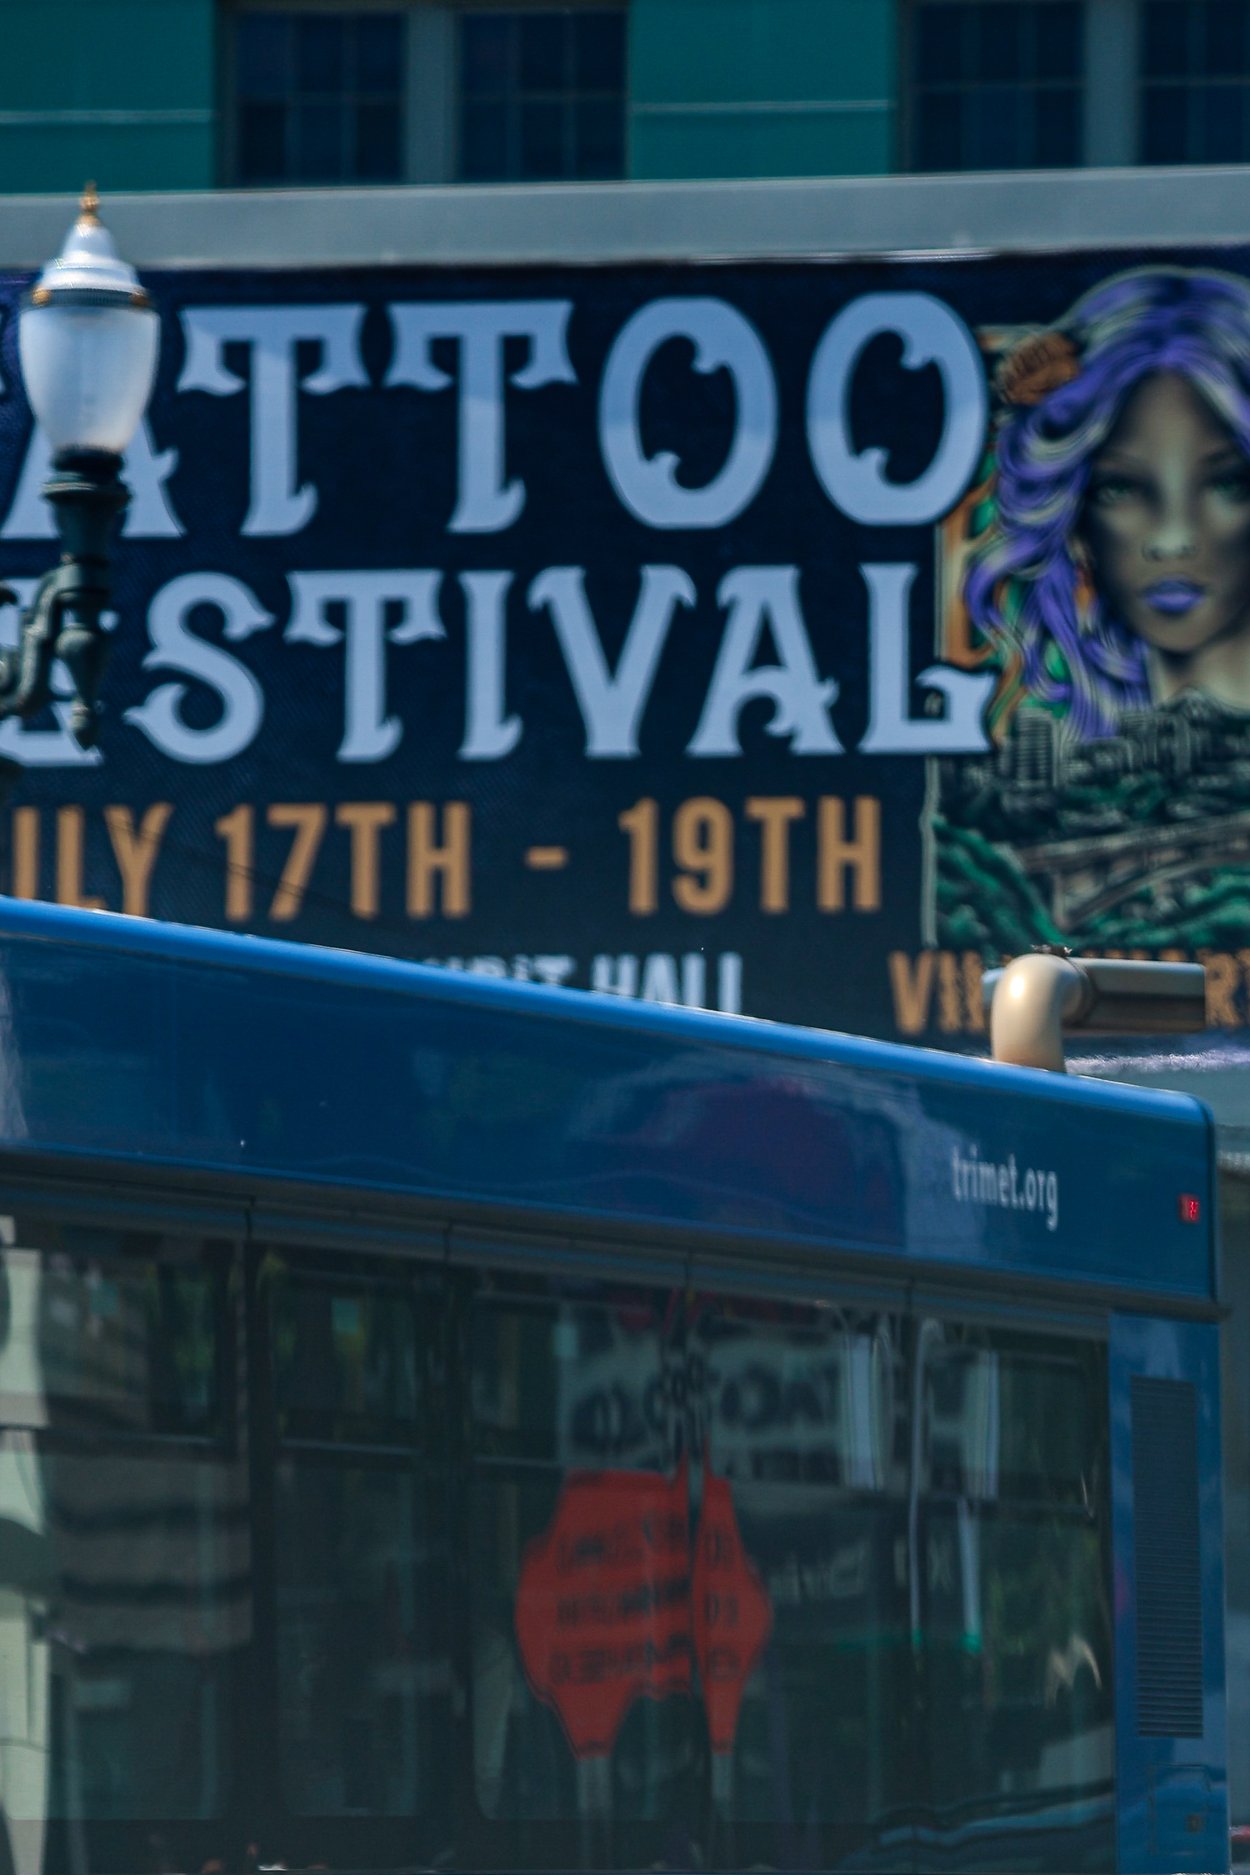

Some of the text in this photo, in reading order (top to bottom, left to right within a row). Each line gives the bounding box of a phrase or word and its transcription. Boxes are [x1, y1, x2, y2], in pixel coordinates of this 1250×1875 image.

[0, 288, 988, 540] ATTOO
[213, 800, 472, 923] 17TH
[618, 795, 883, 917] 19TH
[950, 1142, 1059, 1232] trimet.org
